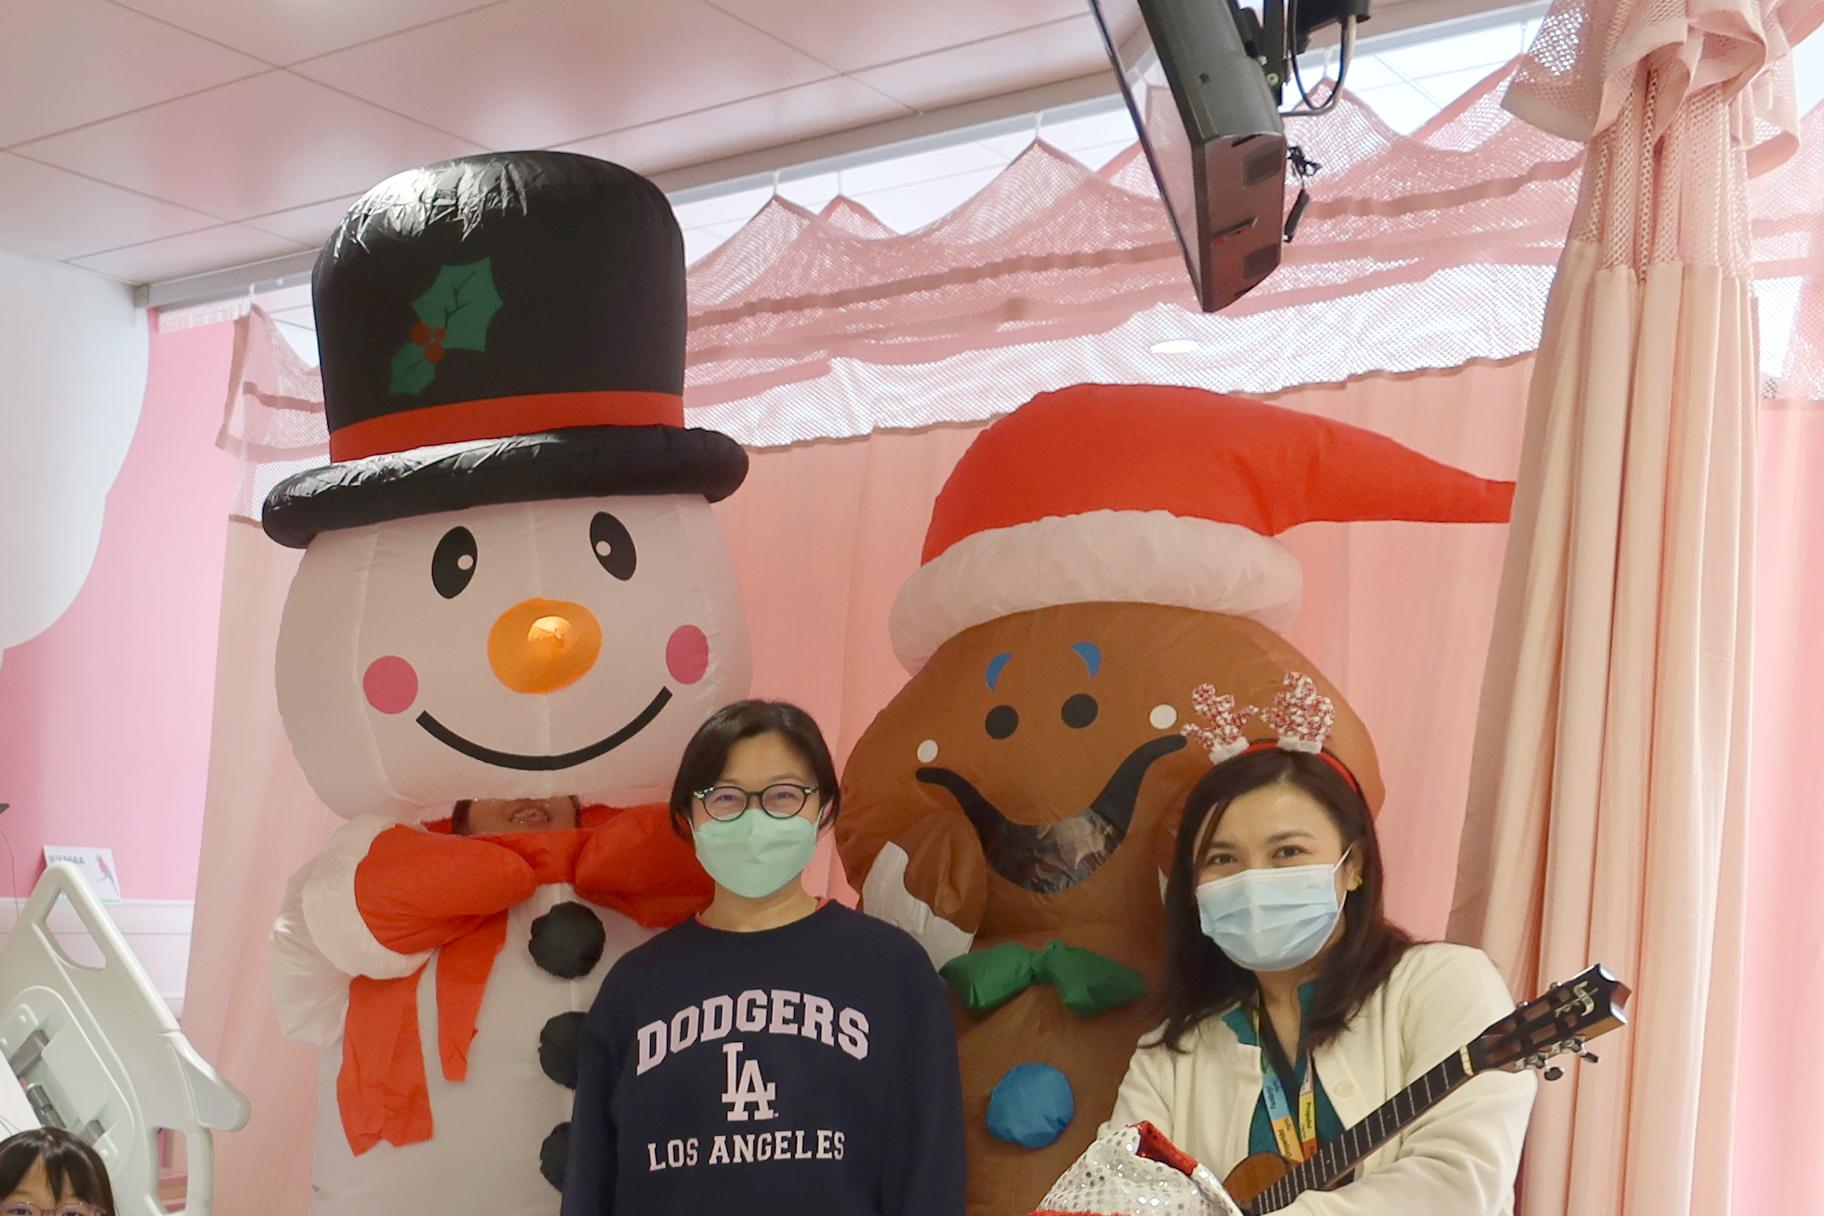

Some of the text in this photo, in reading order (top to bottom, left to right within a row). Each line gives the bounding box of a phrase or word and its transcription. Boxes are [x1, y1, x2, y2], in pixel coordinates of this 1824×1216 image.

[637, 989, 870, 1076] DODGERS
[647, 1130, 846, 1171] LOS ANGELES
